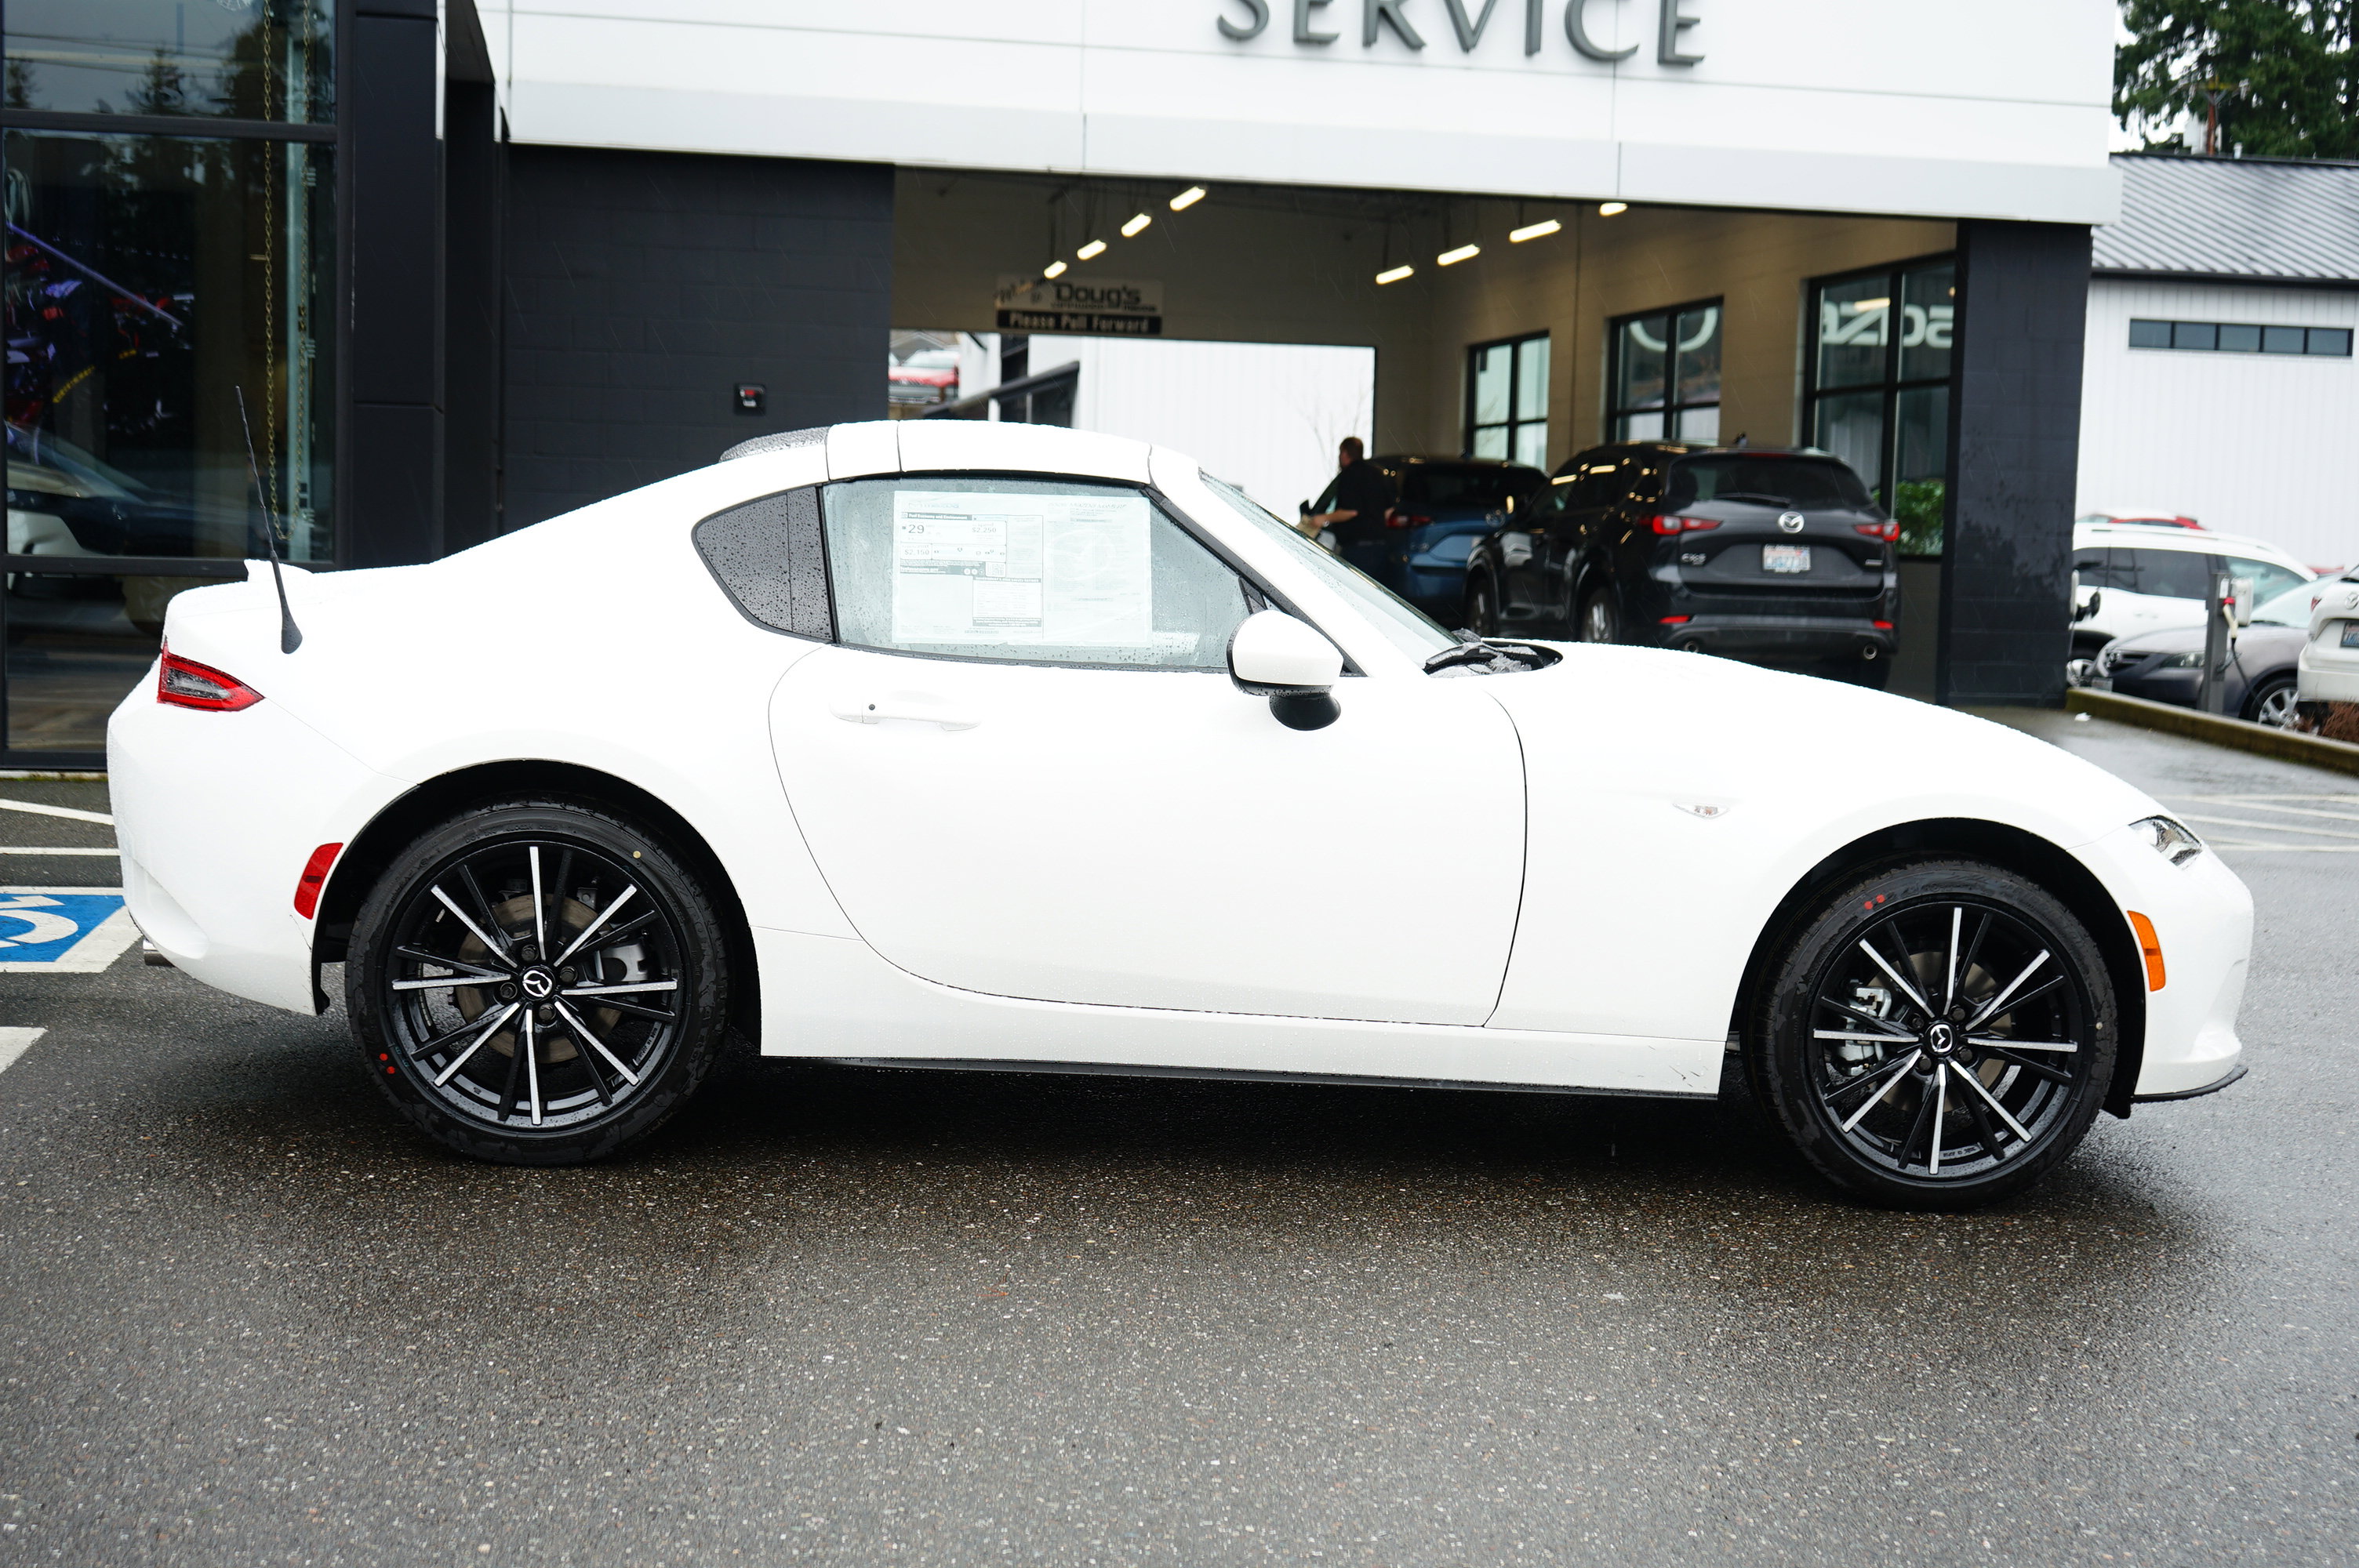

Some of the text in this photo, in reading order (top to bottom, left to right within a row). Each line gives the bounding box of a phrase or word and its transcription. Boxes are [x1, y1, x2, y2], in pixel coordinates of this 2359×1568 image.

[1216, 0, 1706, 66] SERVICE
[1054, 283, 1142, 309] Doug's
[1009, 311, 1147, 333] Please Pull Forward
[908, 524, 925, 534] 29
